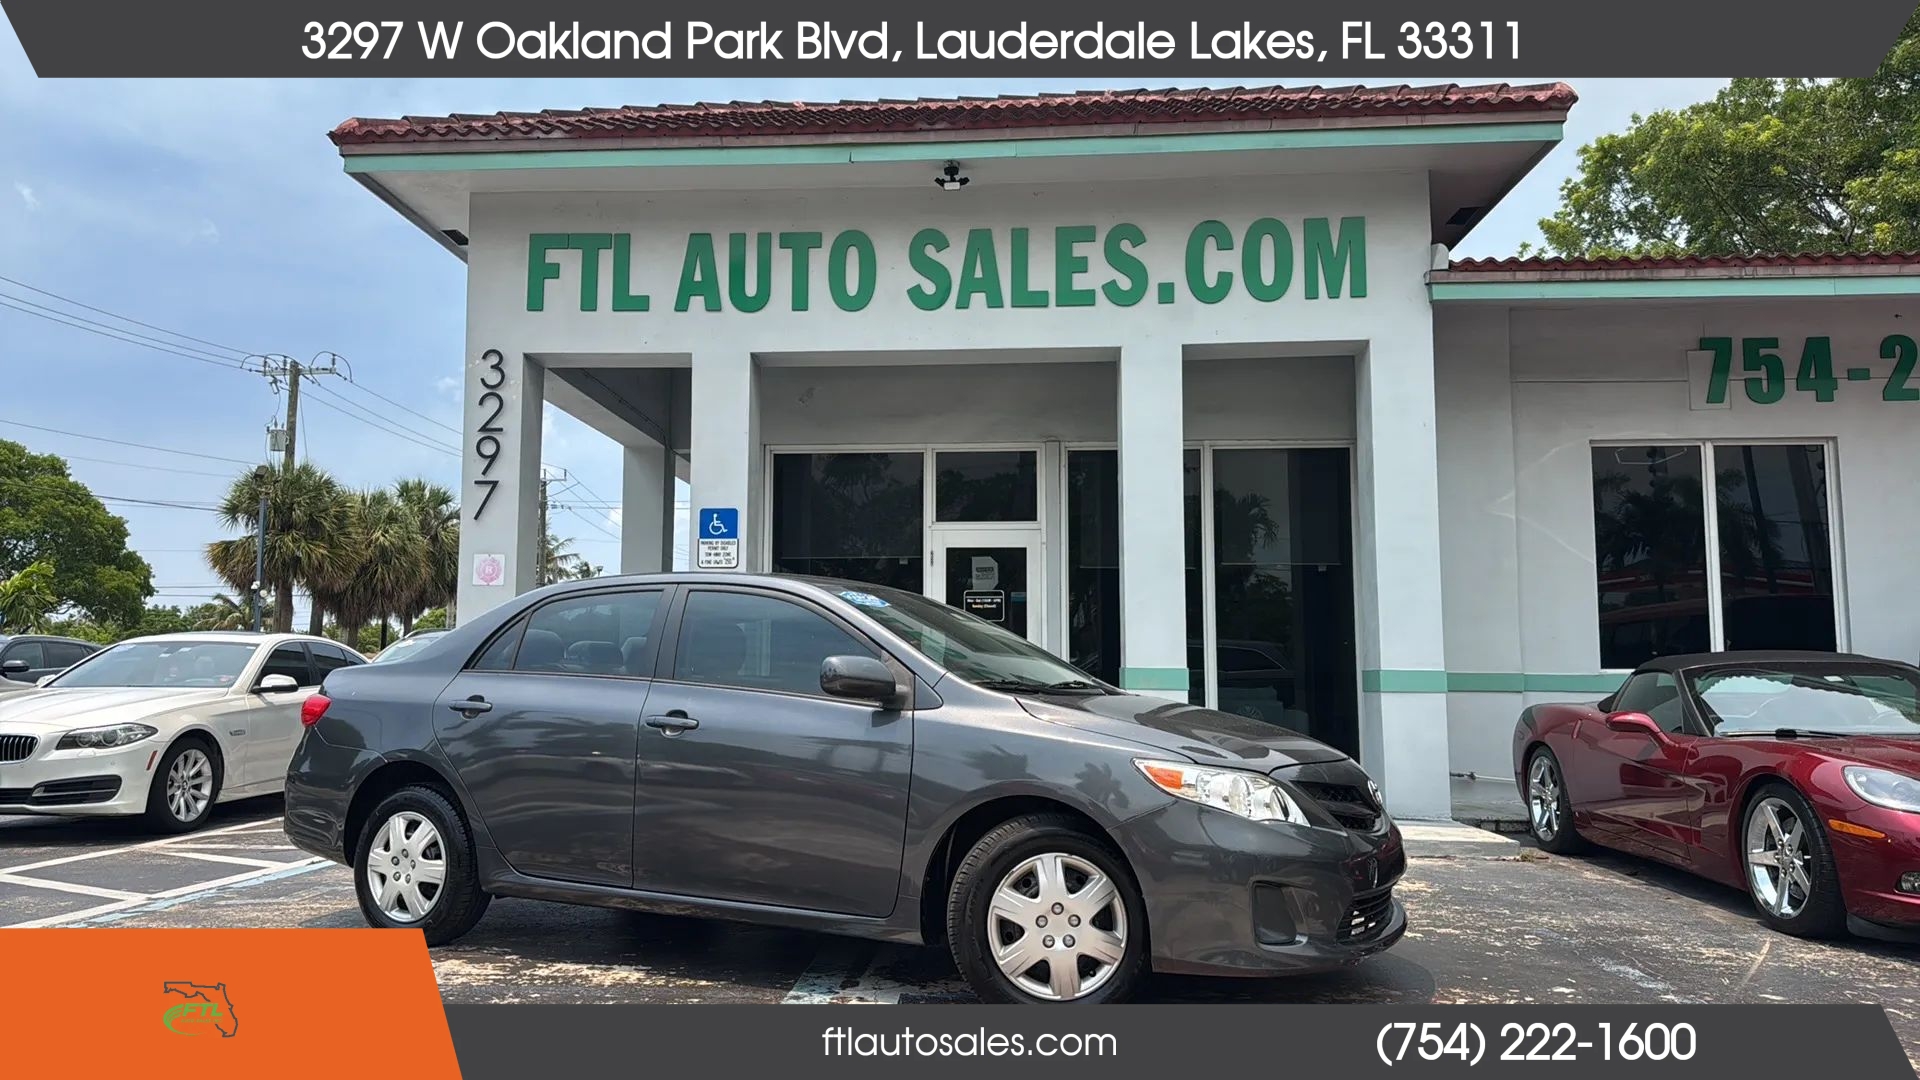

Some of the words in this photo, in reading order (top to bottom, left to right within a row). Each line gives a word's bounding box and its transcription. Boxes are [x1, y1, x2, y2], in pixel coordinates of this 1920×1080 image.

[527, 232, 649, 312] FTL
[675, 229, 877, 313] AUTO
[906, 216, 1367, 311] SALES.COM
[1699, 334, 1920, 404] 754-2
[474, 348, 506, 521] 3297
